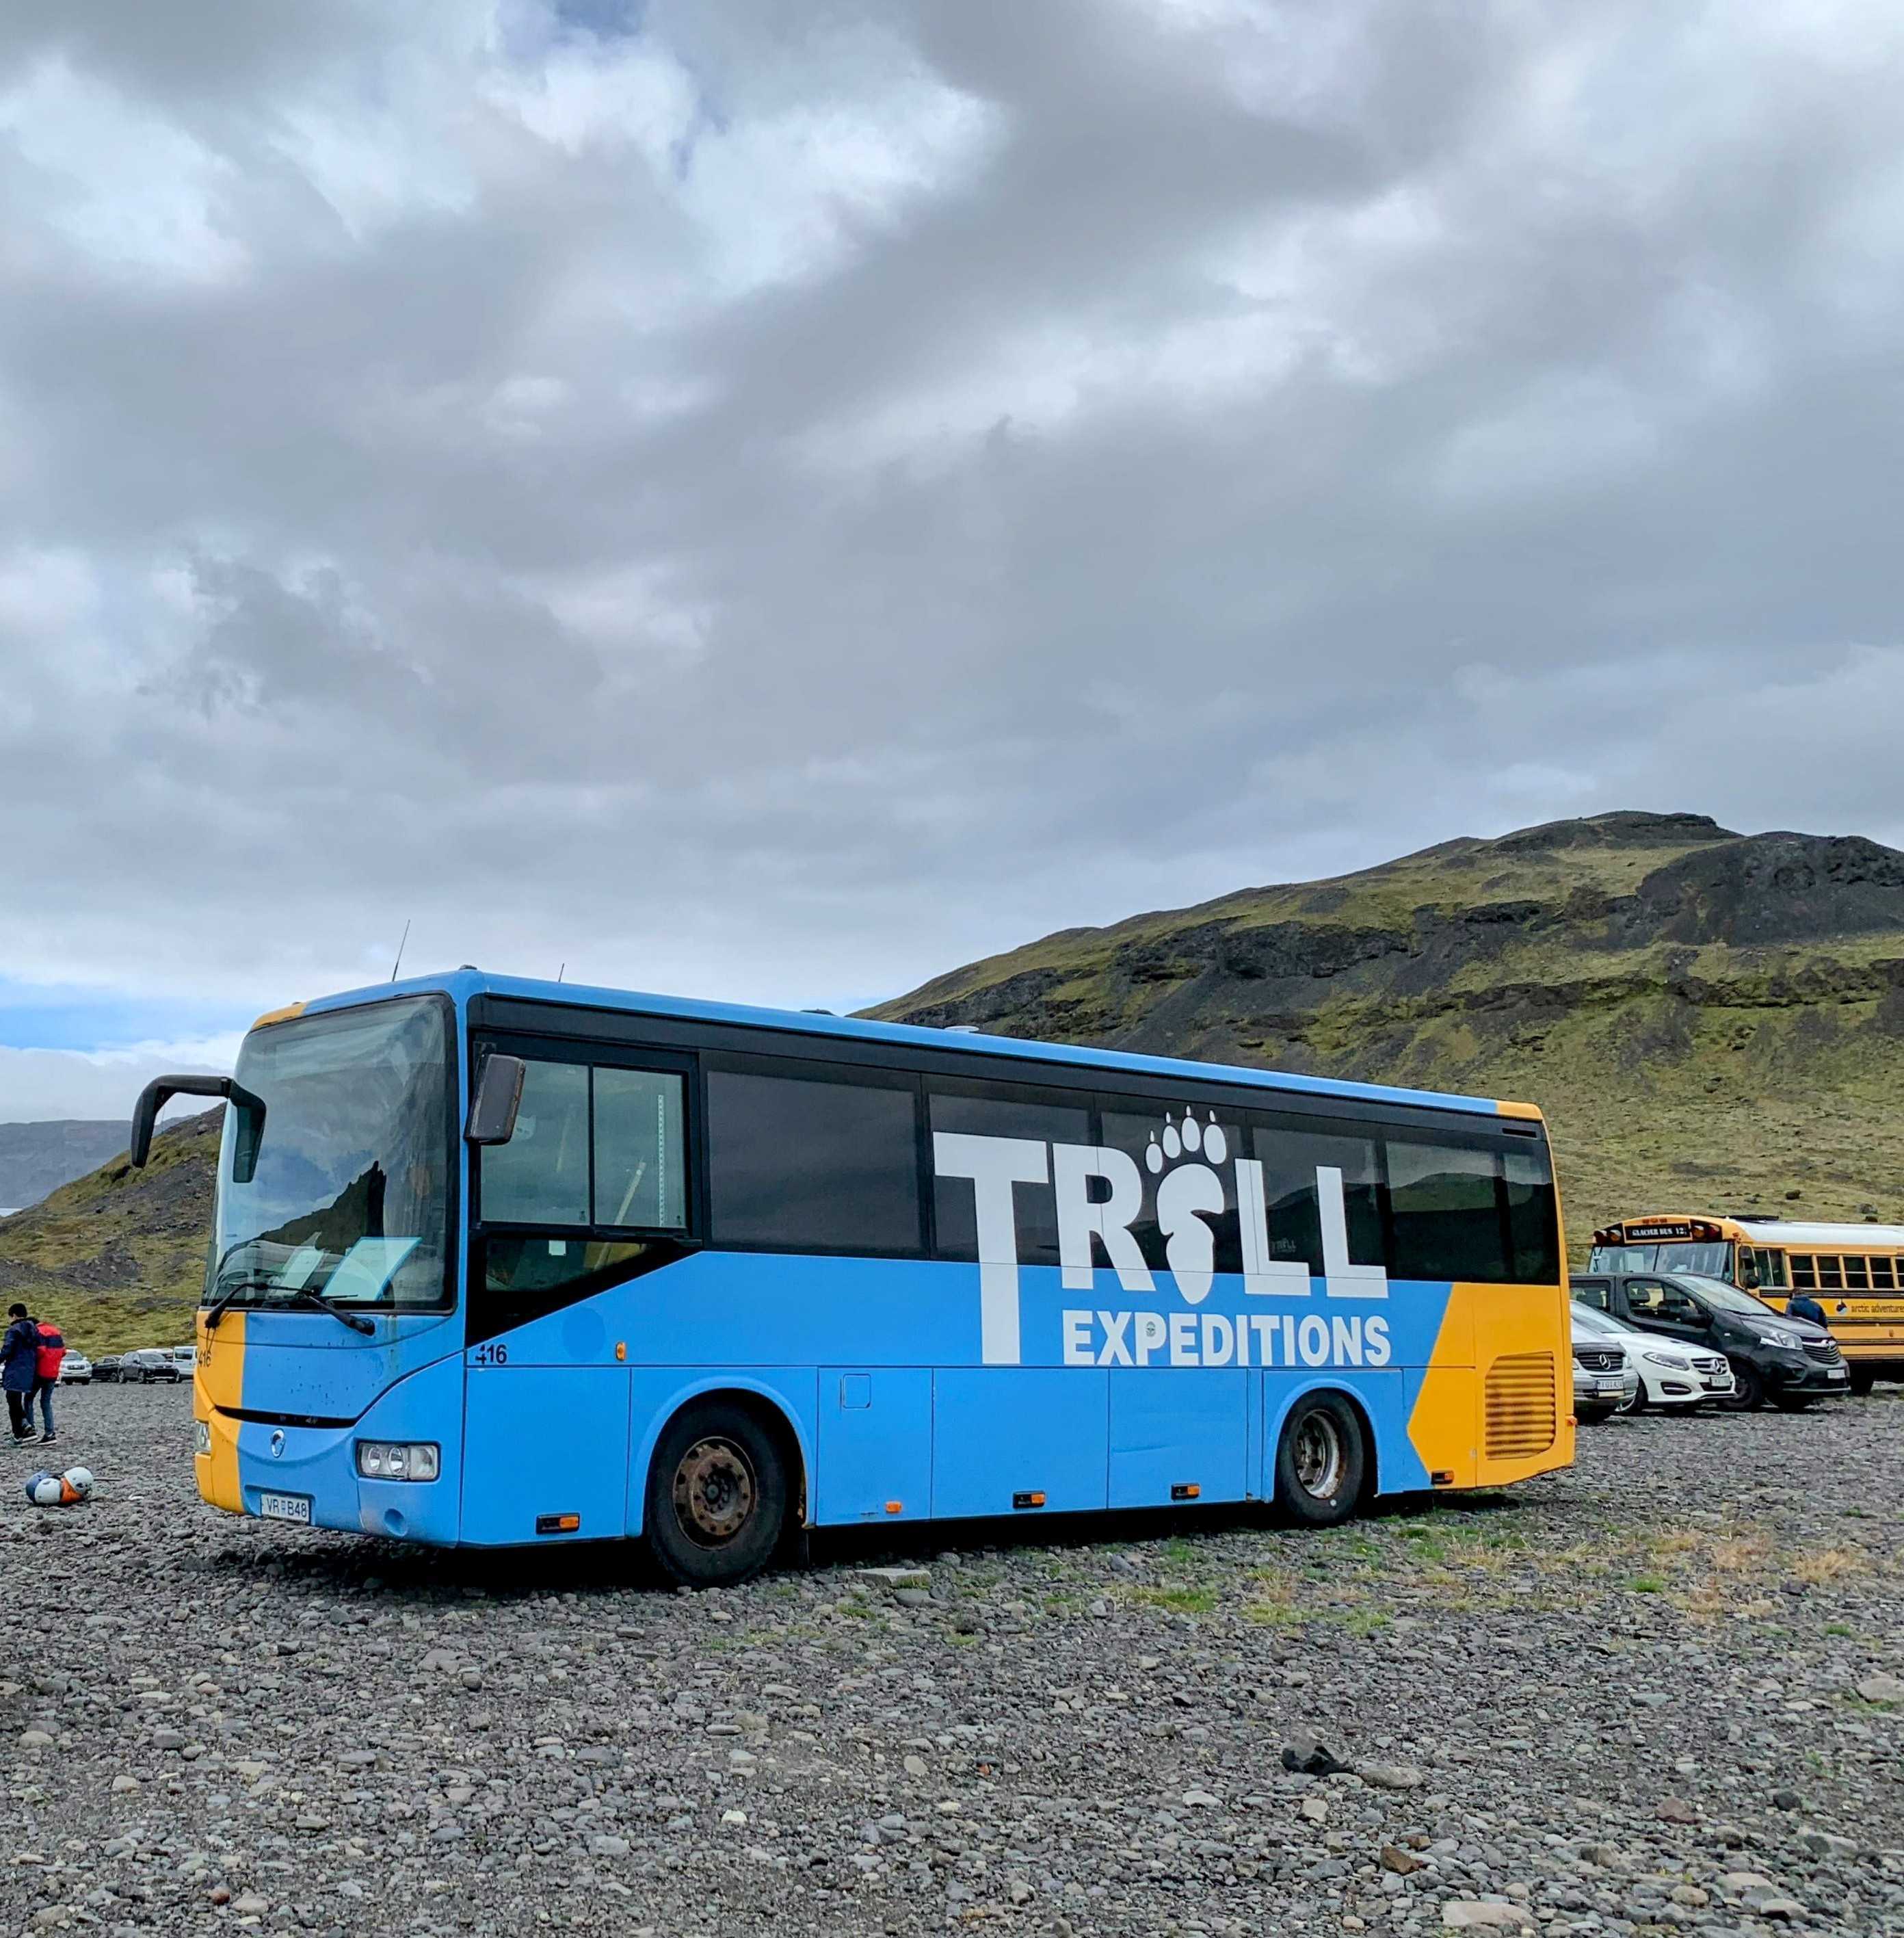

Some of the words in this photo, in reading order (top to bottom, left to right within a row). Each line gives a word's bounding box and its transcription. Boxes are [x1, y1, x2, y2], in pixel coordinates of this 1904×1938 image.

[932, 1107, 1389, 1365] TROLL
[475, 1344, 507, 1365] 416
[1062, 1309, 1391, 1367] EXPEDITIONS
